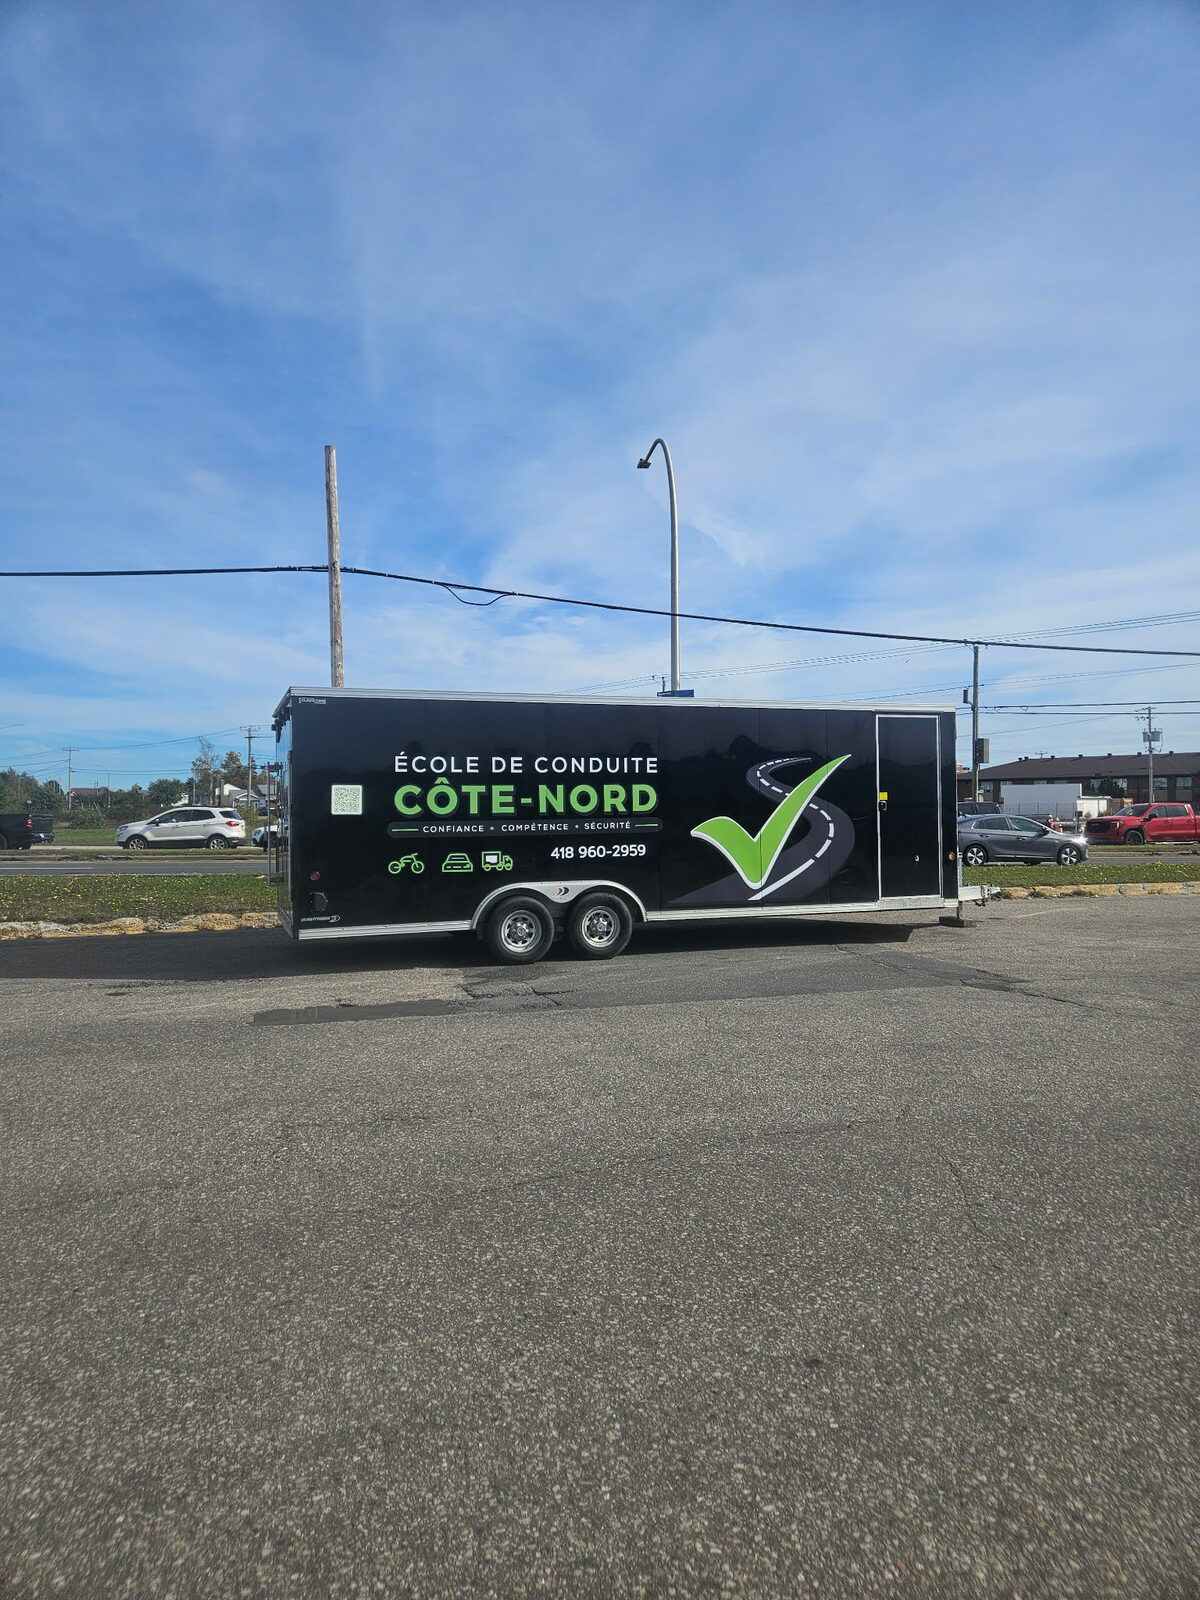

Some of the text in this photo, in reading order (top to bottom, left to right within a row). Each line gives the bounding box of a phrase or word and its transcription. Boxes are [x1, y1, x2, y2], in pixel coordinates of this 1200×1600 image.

[394, 751, 658, 774] ÉCOLE DE CONDUITE
[394, 776, 657, 815] CÔTE-NORD
[422, 820, 631, 833] CONFIANCE COMPÉTENCE SÉCURITÉ
[550, 843, 647, 859] 418 960-2959
